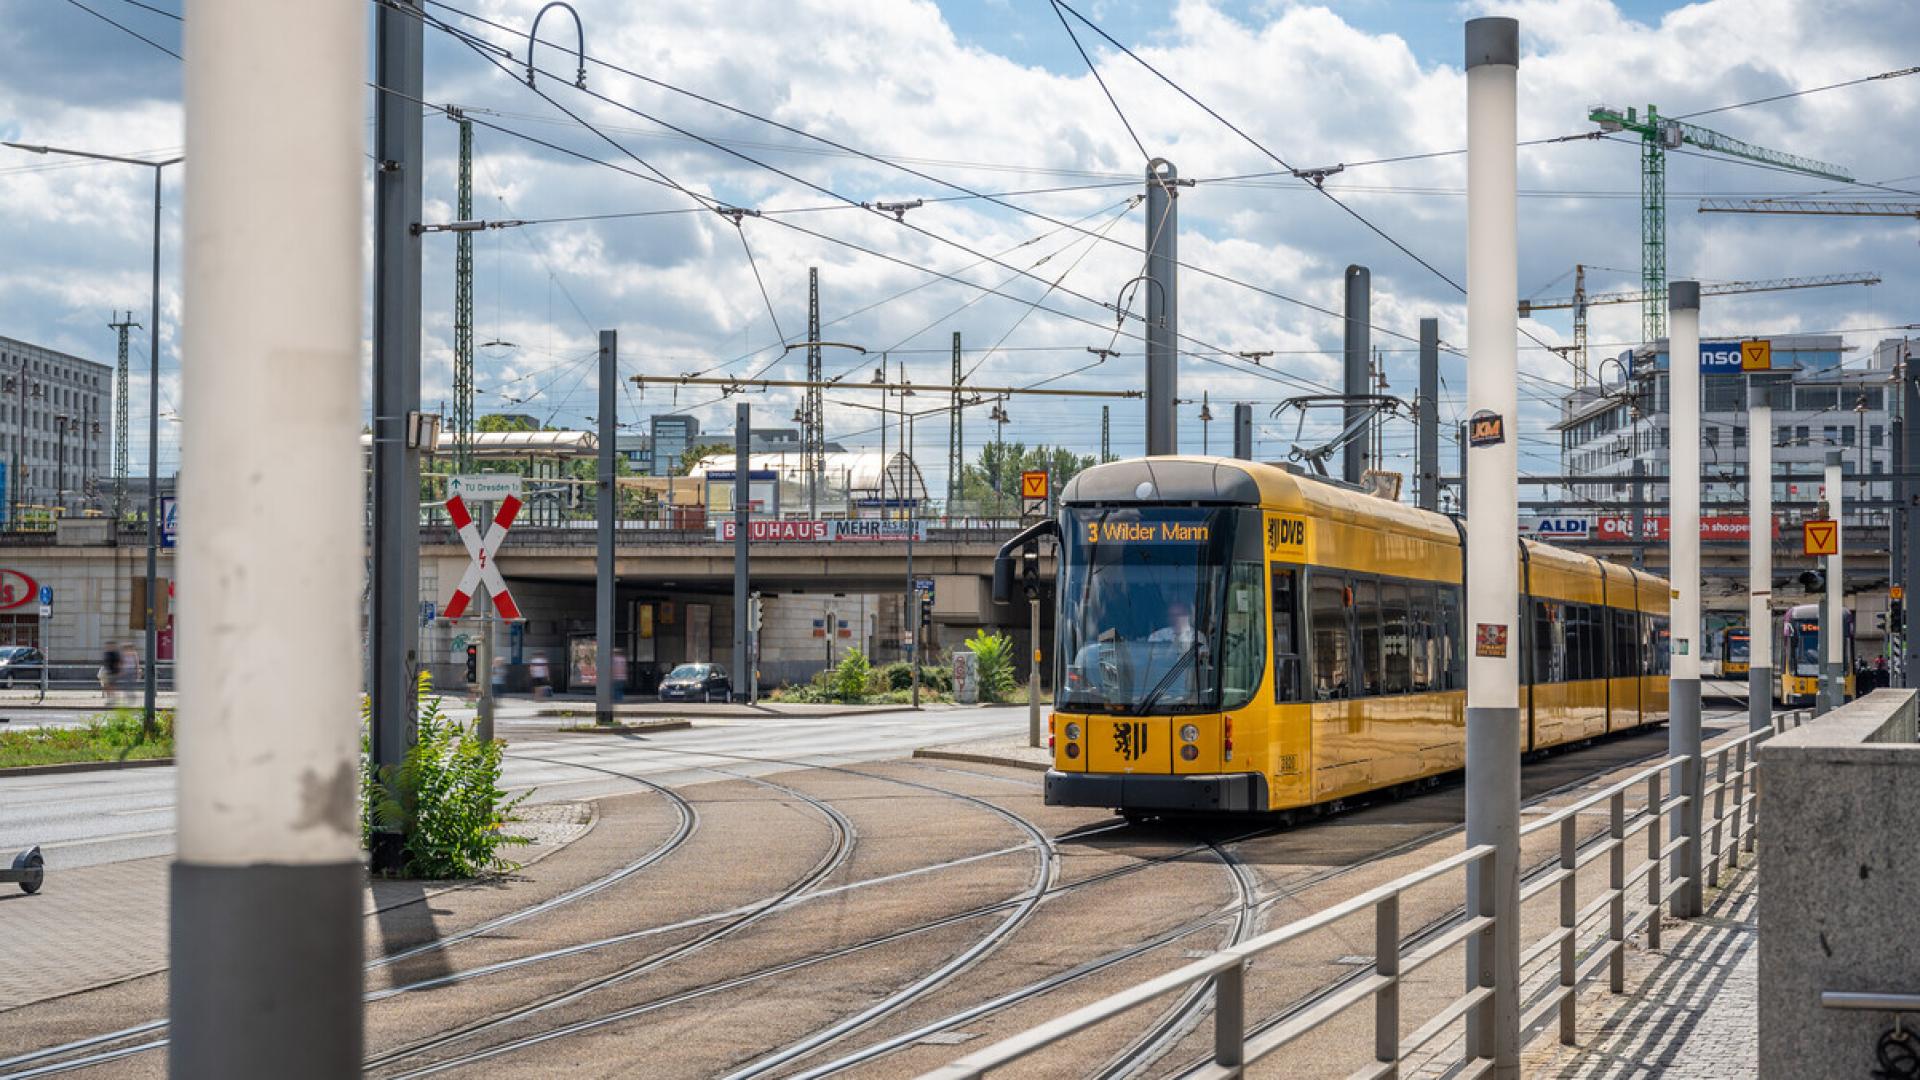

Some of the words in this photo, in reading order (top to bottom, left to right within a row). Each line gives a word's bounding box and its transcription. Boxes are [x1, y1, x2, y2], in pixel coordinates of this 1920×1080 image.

[465, 483, 475, 491] TU
[478, 483, 510, 491] Dresden
[726, 522, 825, 538] BUHAUS
[836, 521, 880, 535] MEHR
[1088, 522, 1099, 542] 3
[1103, 522, 1156, 541] Wilder
[1161, 522, 1209, 541] Mann
[1280, 518, 1304, 545] DVB
[1538, 520, 1587, 532] ALDI
